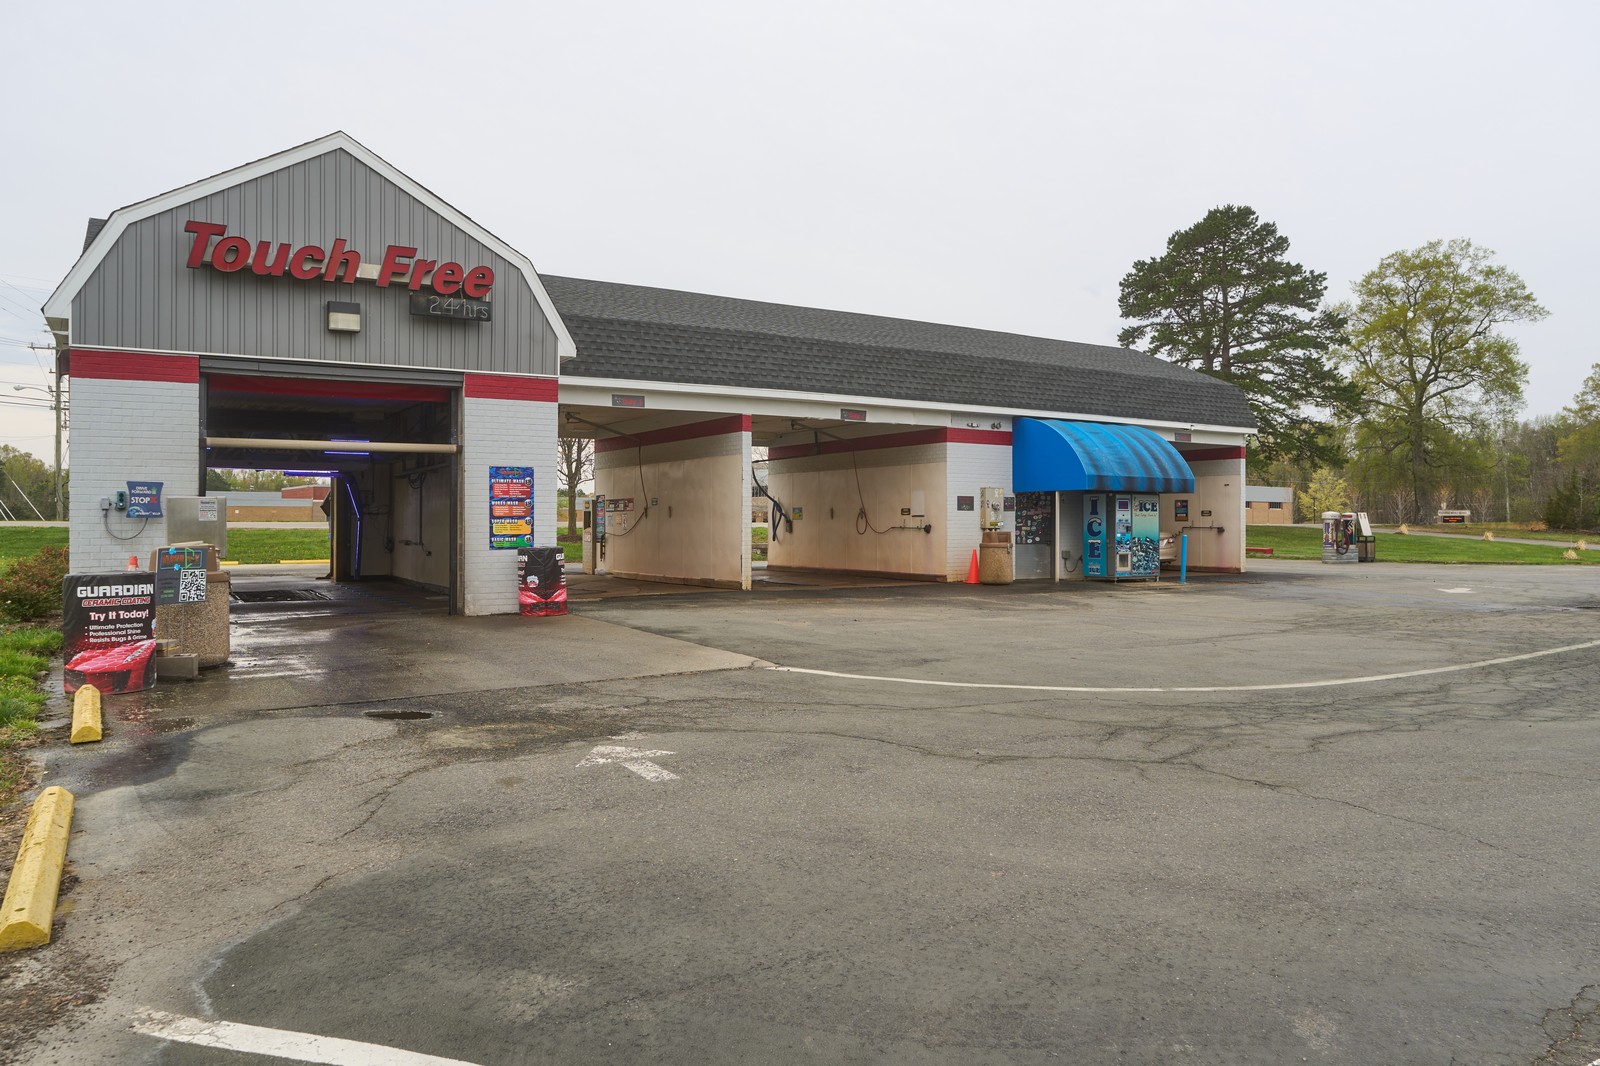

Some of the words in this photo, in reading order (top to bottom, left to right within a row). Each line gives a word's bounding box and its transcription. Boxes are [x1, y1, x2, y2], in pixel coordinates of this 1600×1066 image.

[184, 220, 361, 283] Touch
[376, 245, 494, 298] Free
[429, 295, 459, 315] 24
[462, 298, 488, 318] hrs
[1139, 501, 1157, 512] ICE
[77, 584, 154, 597] GUARDIAN
[82, 598, 120, 607] CERAMIC
[121, 596, 150, 605] COATING
[90, 612, 106, 621] Try
[109, 611, 116, 619] It
[118, 609, 148, 619] Today!
